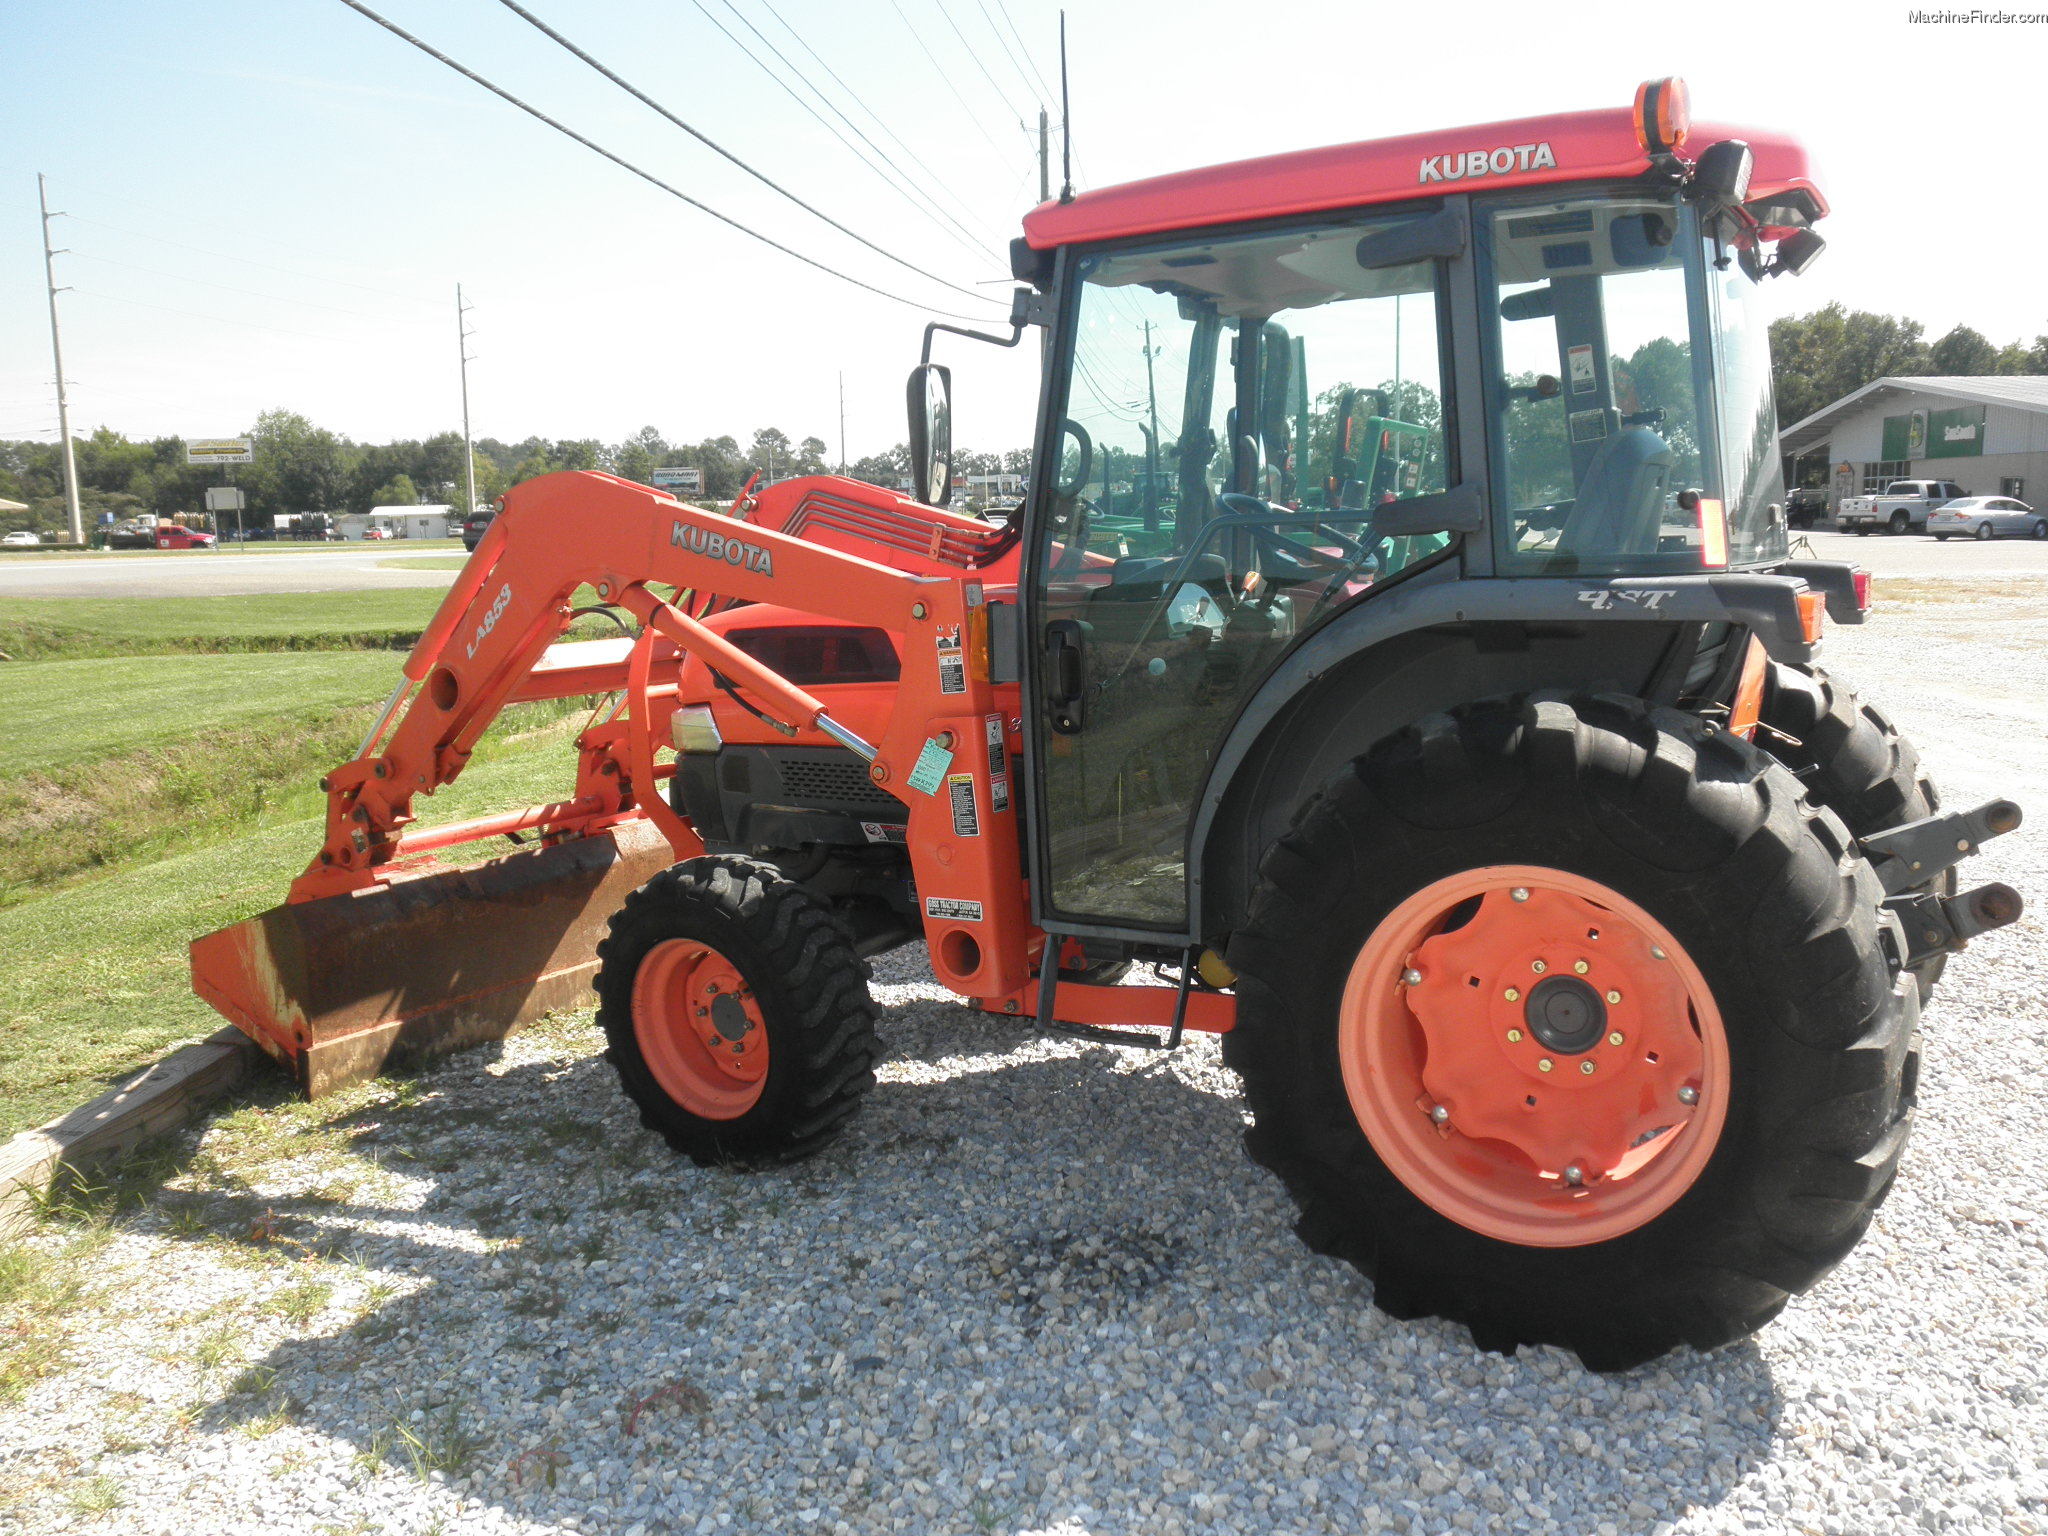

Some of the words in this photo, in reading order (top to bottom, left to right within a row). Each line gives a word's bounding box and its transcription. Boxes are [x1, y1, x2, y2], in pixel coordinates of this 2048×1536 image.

[1419, 142, 1557, 184] KUBOTA
[671, 520, 774, 578] KUBOTA
[466, 583, 511, 660] LA853
